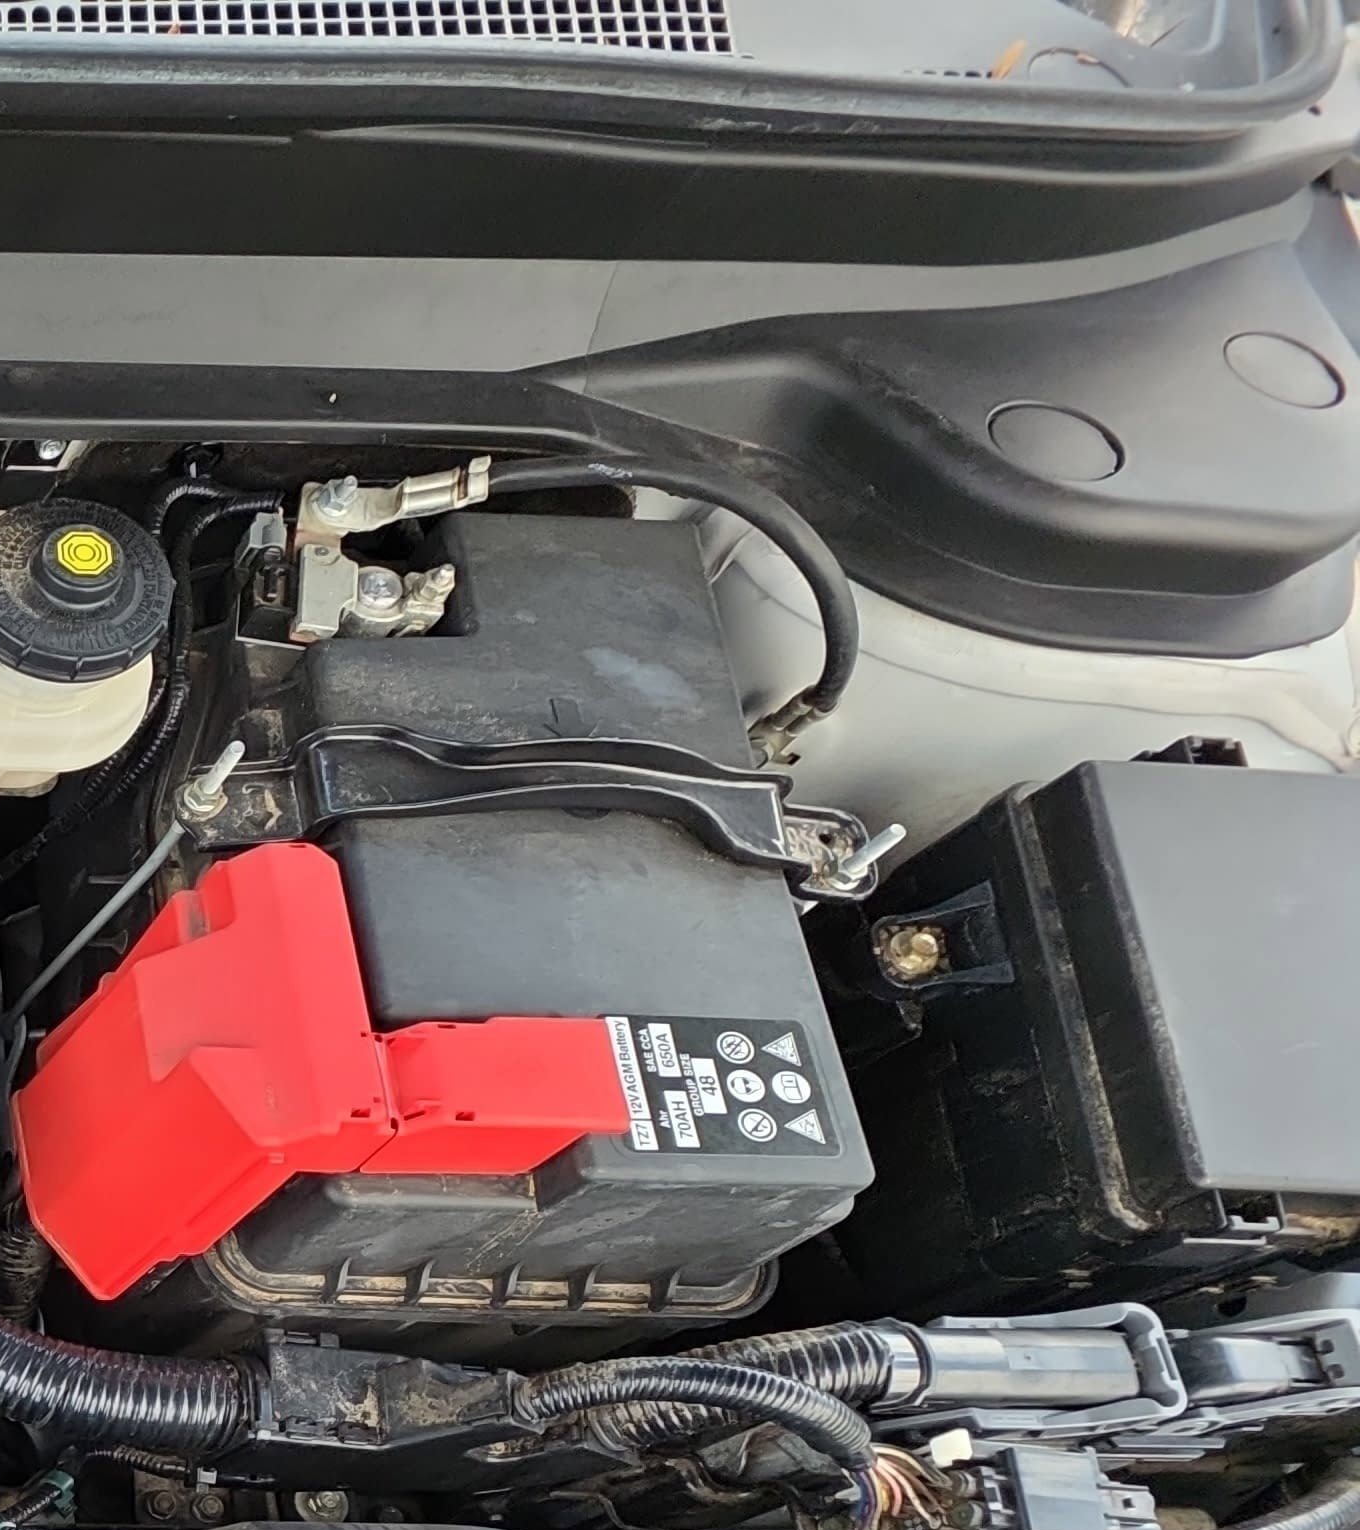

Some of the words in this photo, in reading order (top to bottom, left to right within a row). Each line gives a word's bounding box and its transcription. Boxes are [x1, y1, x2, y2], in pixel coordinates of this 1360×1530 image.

[614, 1020, 631, 1061] Battery
[638, 1028, 652, 1050] CCA
[655, 1033, 675, 1069] 650A
[643, 1050, 657, 1073] SAE
[679, 1053, 694, 1077] SIZE
[685, 1078, 705, 1117] GROUP
[698, 1075, 718, 1097] 48
[658, 1110, 672, 1129] Ahr
[671, 1100, 694, 1138] 70AH
[636, 1123, 650, 1147] TZ7
